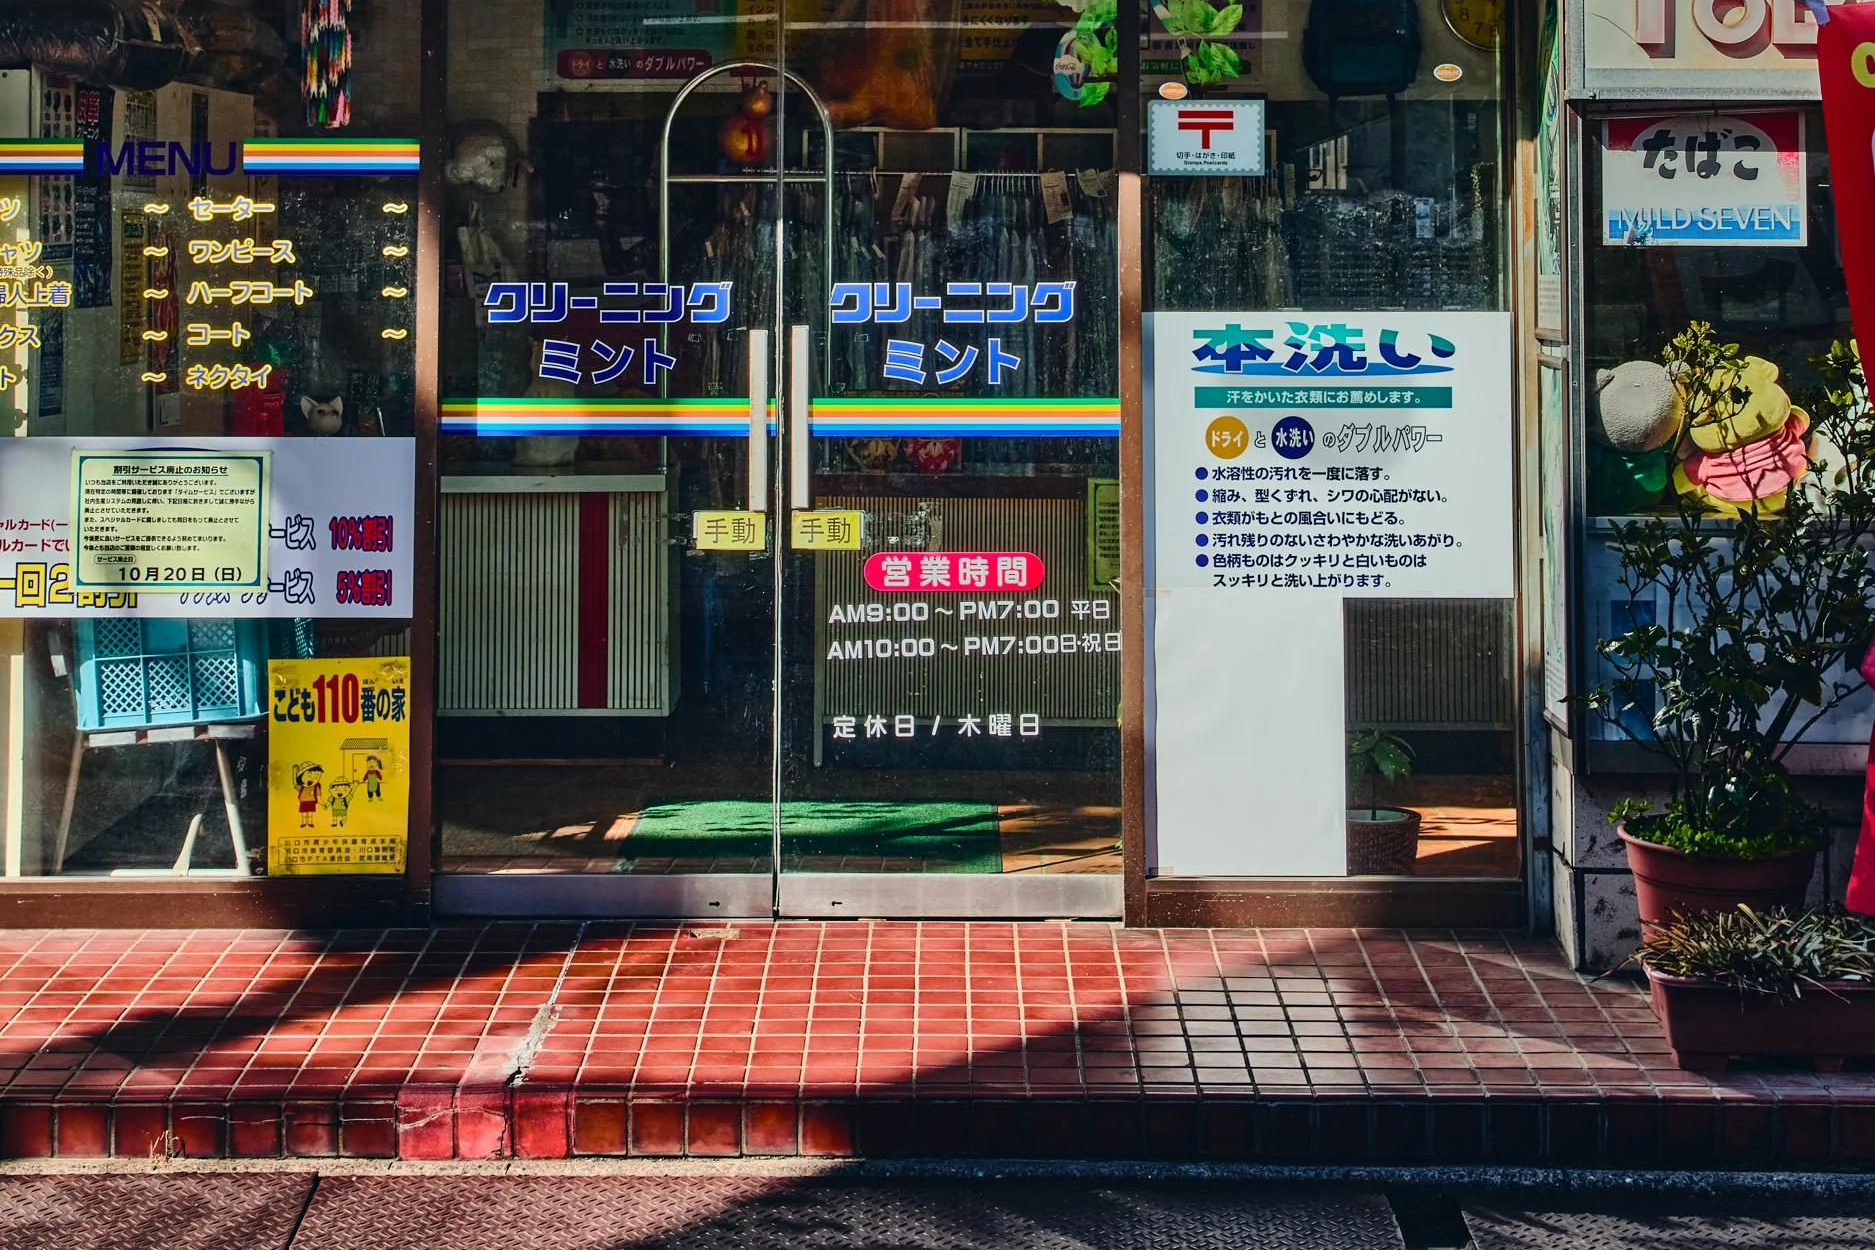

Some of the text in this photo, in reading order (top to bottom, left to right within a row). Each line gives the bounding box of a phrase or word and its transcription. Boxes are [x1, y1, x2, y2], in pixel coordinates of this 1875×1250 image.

[95, 141, 237, 176] MENU
[1643, 128, 1760, 181] たばこ
[188, 195, 275, 222] セーター
[1618, 206, 1793, 231] MILD SEVEN
[188, 238, 296, 265] ワンピース
[187, 280, 313, 305] ハーフコート
[483, 280, 732, 323] クリーニング
[830, 280, 1078, 323] クリーニング
[187, 322, 251, 348] コート
[1192, 321, 1456, 373] 本洗い
[538, 337, 676, 385] ミント
[883, 336, 1021, 385] ミント
[186, 364, 273, 390] ネクタイ
[1226, 389, 1421, 405] 汗をかいた衣類にお薦めします。
[1210, 428, 1245, 446] ドライ
[1254, 430, 1266, 448] と
[1275, 427, 1315, 447] 水洗い
[113, 465, 228, 475] 割引サービス廃止のお知らせ
[1212, 466, 1391, 482] 水溶性の汚れを一度に落す。
[1212, 488, 1449, 504] 縮み、型くずれ、シワの心配がない。
[799, 517, 852, 544] 手動
[1212, 510, 1405, 526] 衣類がもとの風合いにもどる。
[269, 514, 394, 552] ービス 10%割引
[703, 518, 756, 545] 手動
[1212, 533, 1463, 548] 汚れ残りのないさわやかな洗いあがり。
[880, 555, 1028, 588] 営業時間
[1212, 553, 1427, 568] 色柄ものはクッキリと白いものは
[268, 567, 393, 606] ービス 5%割引
[1212, 573, 1392, 588] スッキリと洗い上がります。
[1070, 599, 1110, 621] 平日
[273, 673, 406, 723] こども110番の家
[832, 714, 916, 739] 定休日
[958, 713, 1040, 738] 木曜日
